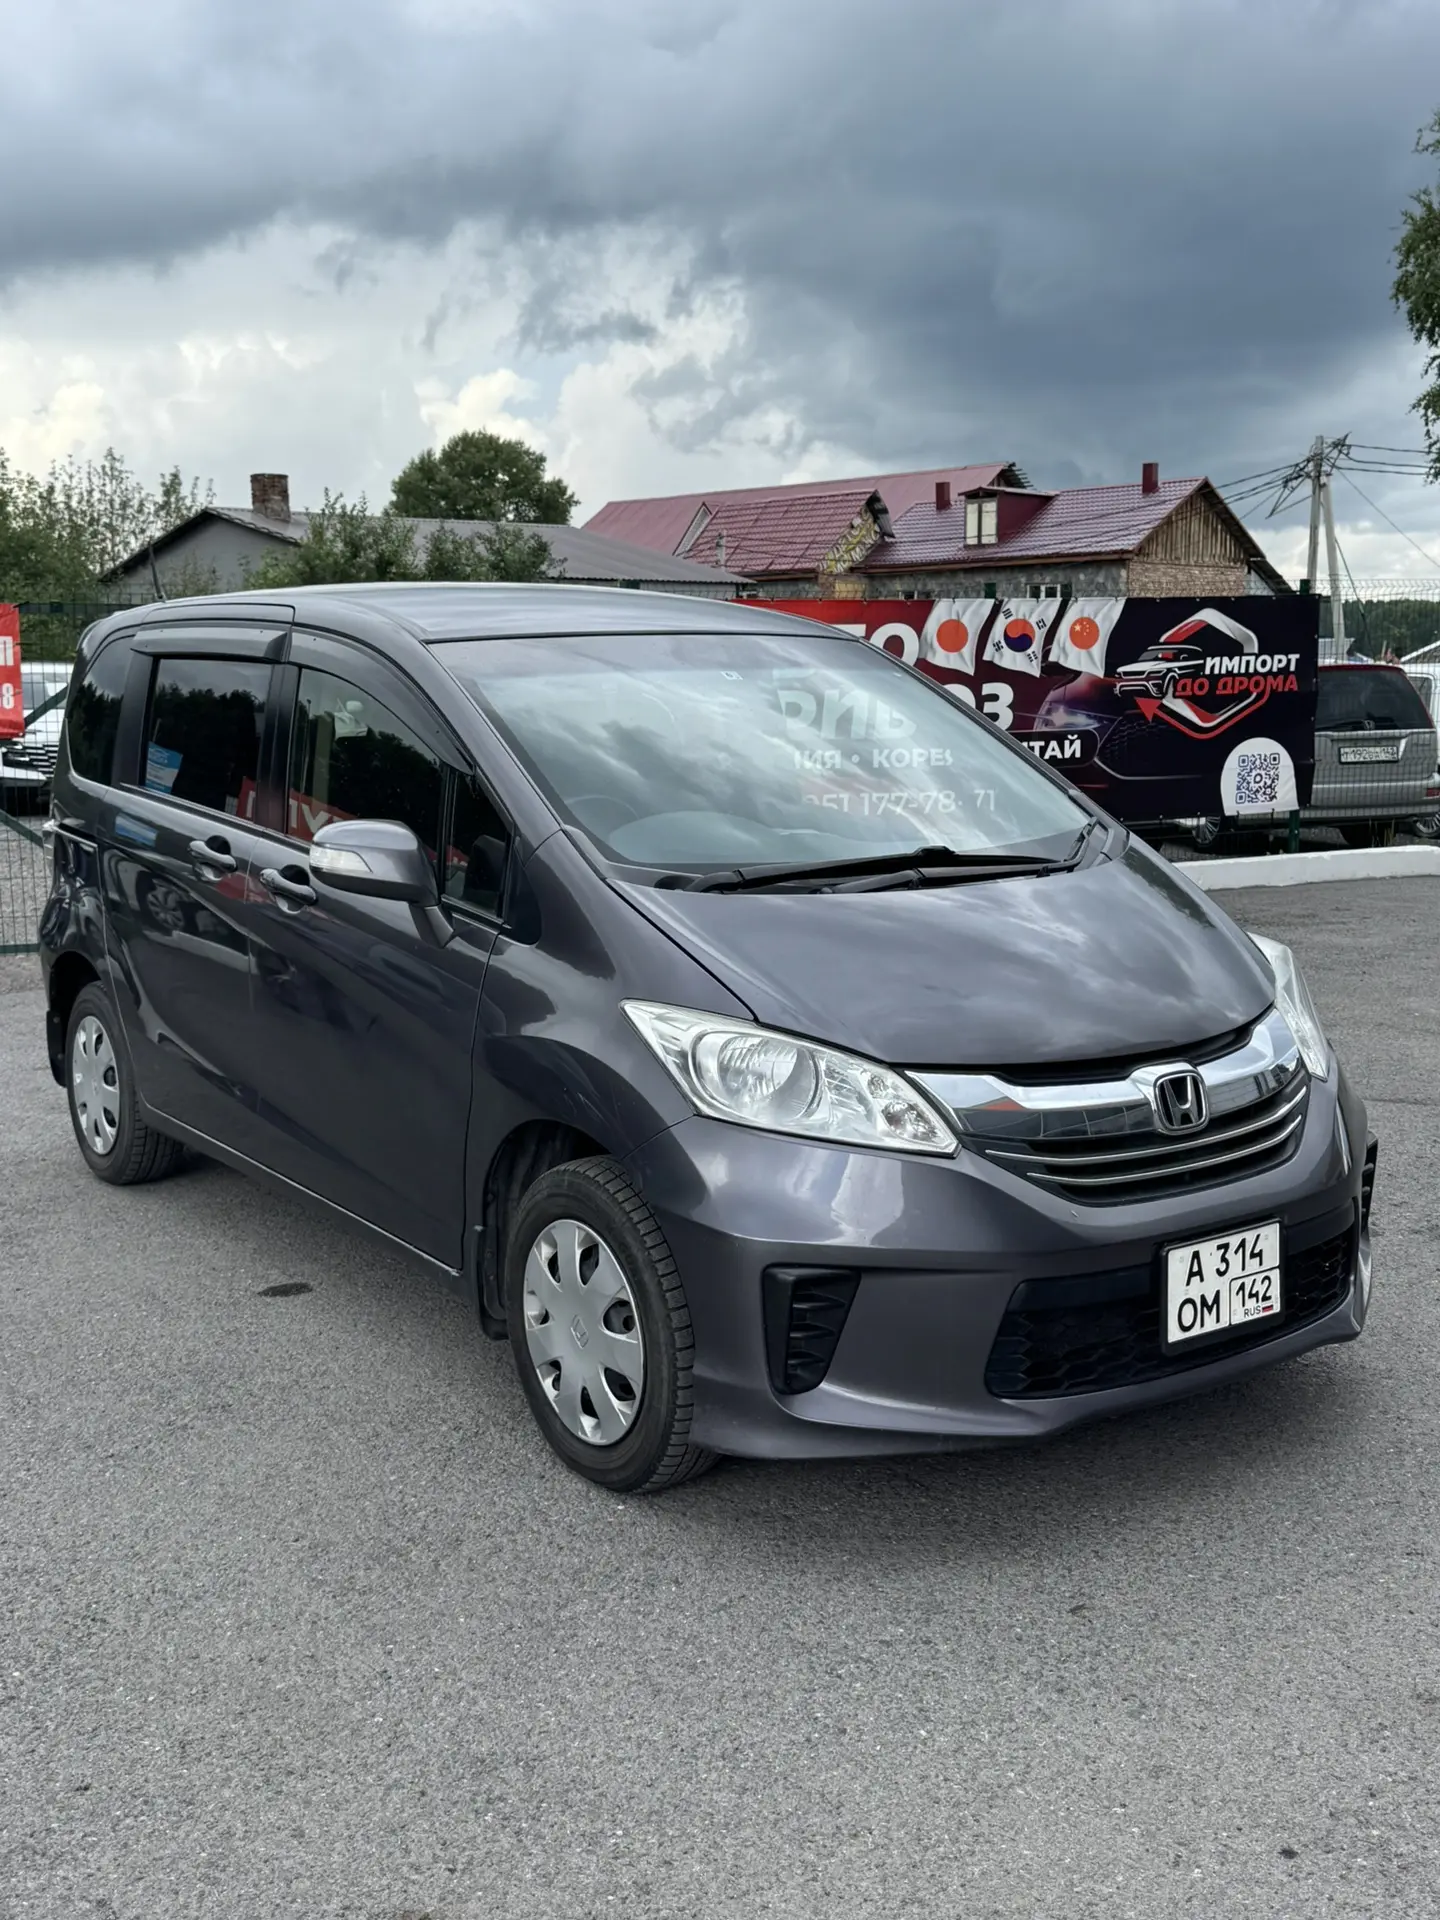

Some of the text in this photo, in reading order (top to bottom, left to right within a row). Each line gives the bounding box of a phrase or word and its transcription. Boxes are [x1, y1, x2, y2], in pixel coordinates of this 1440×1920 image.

[1204, 653, 1300, 675] ИМПОРТ
[1175, 674, 1298, 696] ДО ДРОМА
[1185, 1233, 1263, 1287] А 314
[1177, 1275, 1273, 1333] ОМ 142
[1243, 1305, 1261, 1318] RUS
